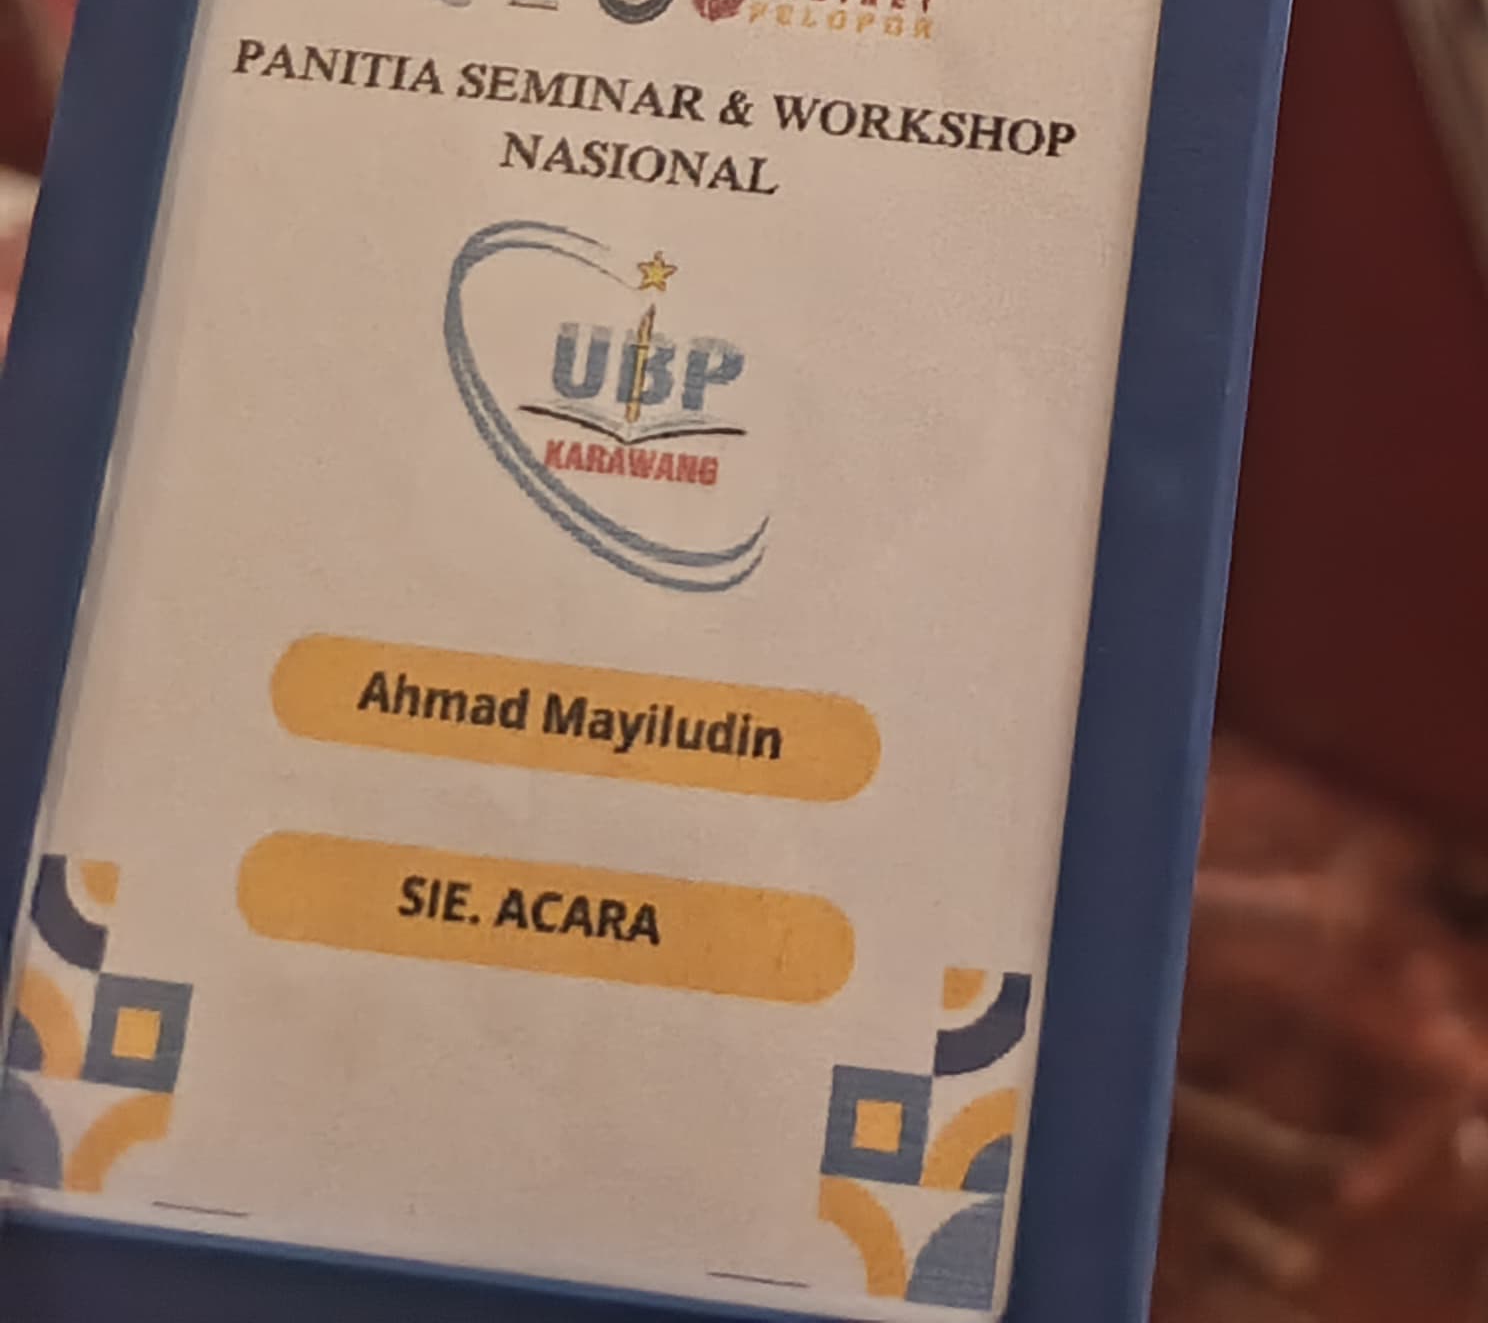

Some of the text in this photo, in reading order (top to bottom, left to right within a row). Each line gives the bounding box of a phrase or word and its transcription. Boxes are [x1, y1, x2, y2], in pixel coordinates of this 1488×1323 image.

[749, 1, 934, 40] PELOPOR
[232, 39, 1077, 158] PANITIA SEMINAR & WORKSHOP
[499, 131, 780, 196] NASIONAL
[552, 321, 746, 411] UBP
[544, 439, 719, 486] KARAWANG
[356, 671, 784, 760] Ahmad Mayiludin
[398, 875, 661, 946] SIE. ACARA
